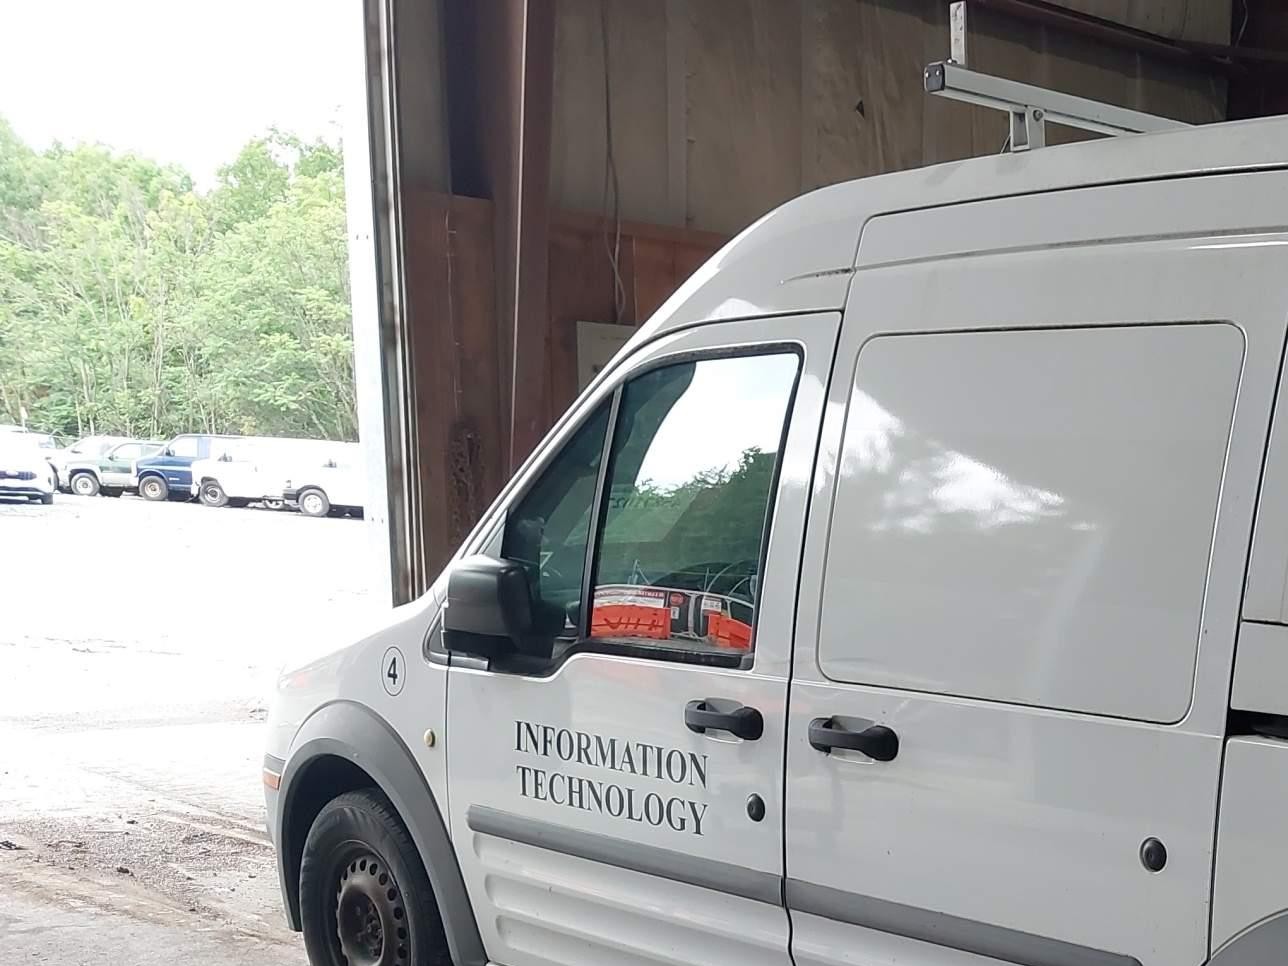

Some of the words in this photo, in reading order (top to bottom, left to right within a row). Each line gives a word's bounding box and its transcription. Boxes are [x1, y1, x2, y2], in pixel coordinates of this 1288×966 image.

[387, 657, 398, 685] 4
[513, 720, 709, 790] INFORMATION
[515, 765, 709, 836] TECHNOLOGY
